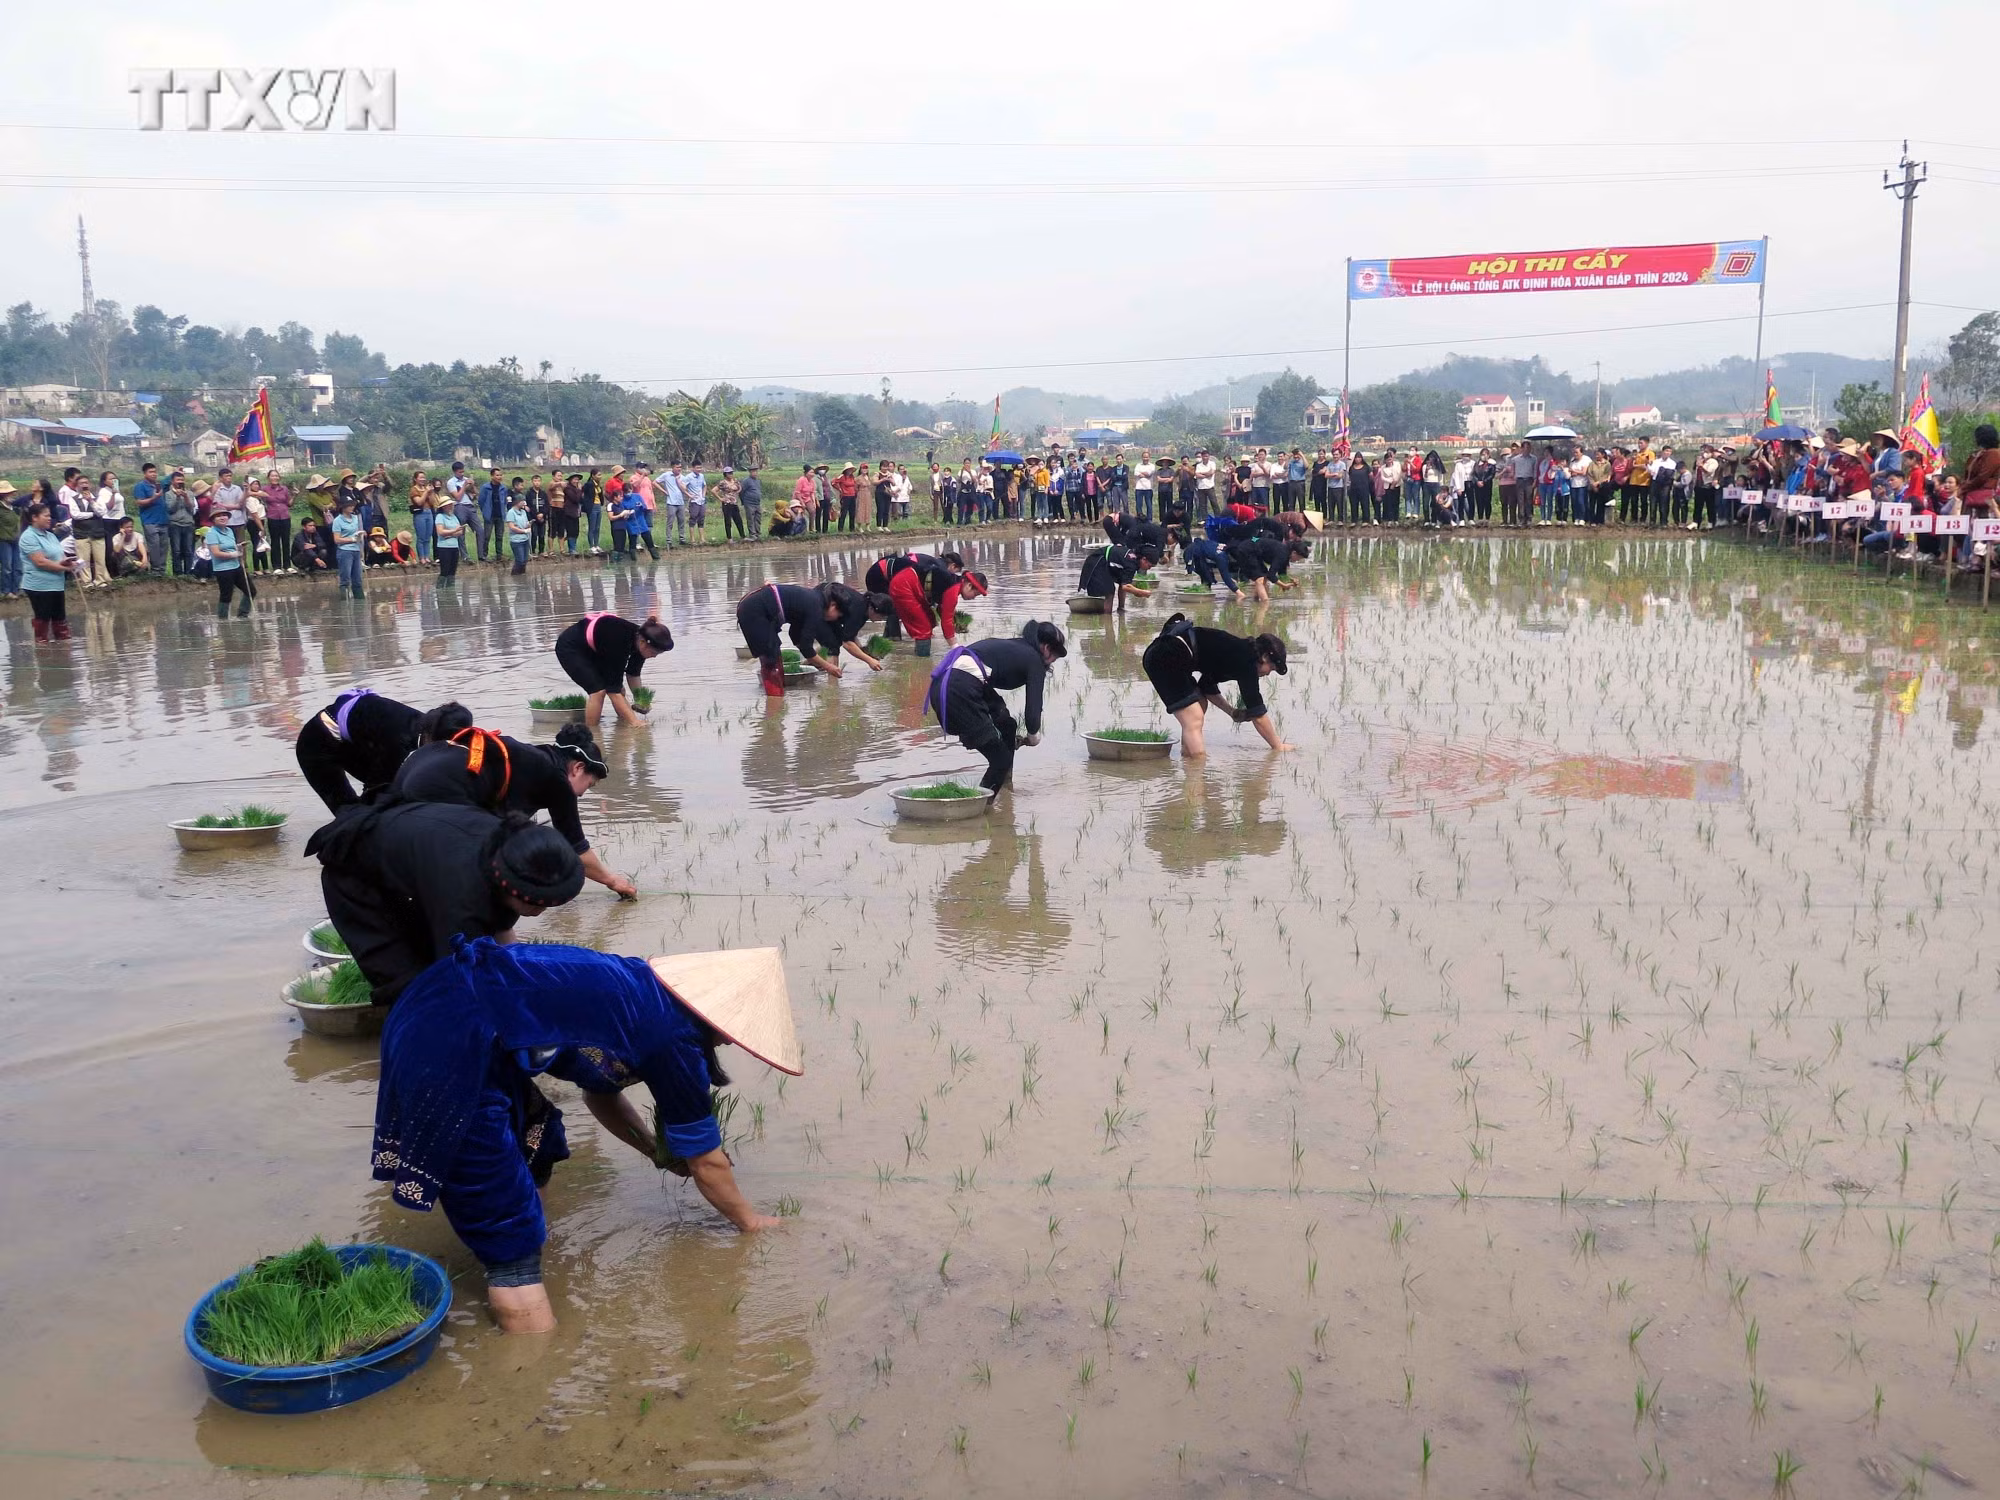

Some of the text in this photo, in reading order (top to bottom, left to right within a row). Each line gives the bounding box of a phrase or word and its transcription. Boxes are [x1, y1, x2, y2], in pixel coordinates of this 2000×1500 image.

[1466, 248, 1629, 278] HỘI THI CẤY
[1425, 281, 1442, 295] HỘI
[1502, 278, 1521, 290] ATK
[1523, 278, 1548, 291] ĐỊNH
[1574, 273, 1604, 287] XUÂN
[1606, 272, 1632, 286] GIÁP
[1634, 271, 1659, 284] THÌN
[1661, 272, 1689, 283] 2024
[1831, 506, 1841, 514] 17
[1855, 504, 1867, 512] 16
[1890, 508, 1903, 516] 15
[1910, 519, 1923, 528] 14
[1945, 520, 1960, 529] 13
[1984, 525, 2000, 535] 12
